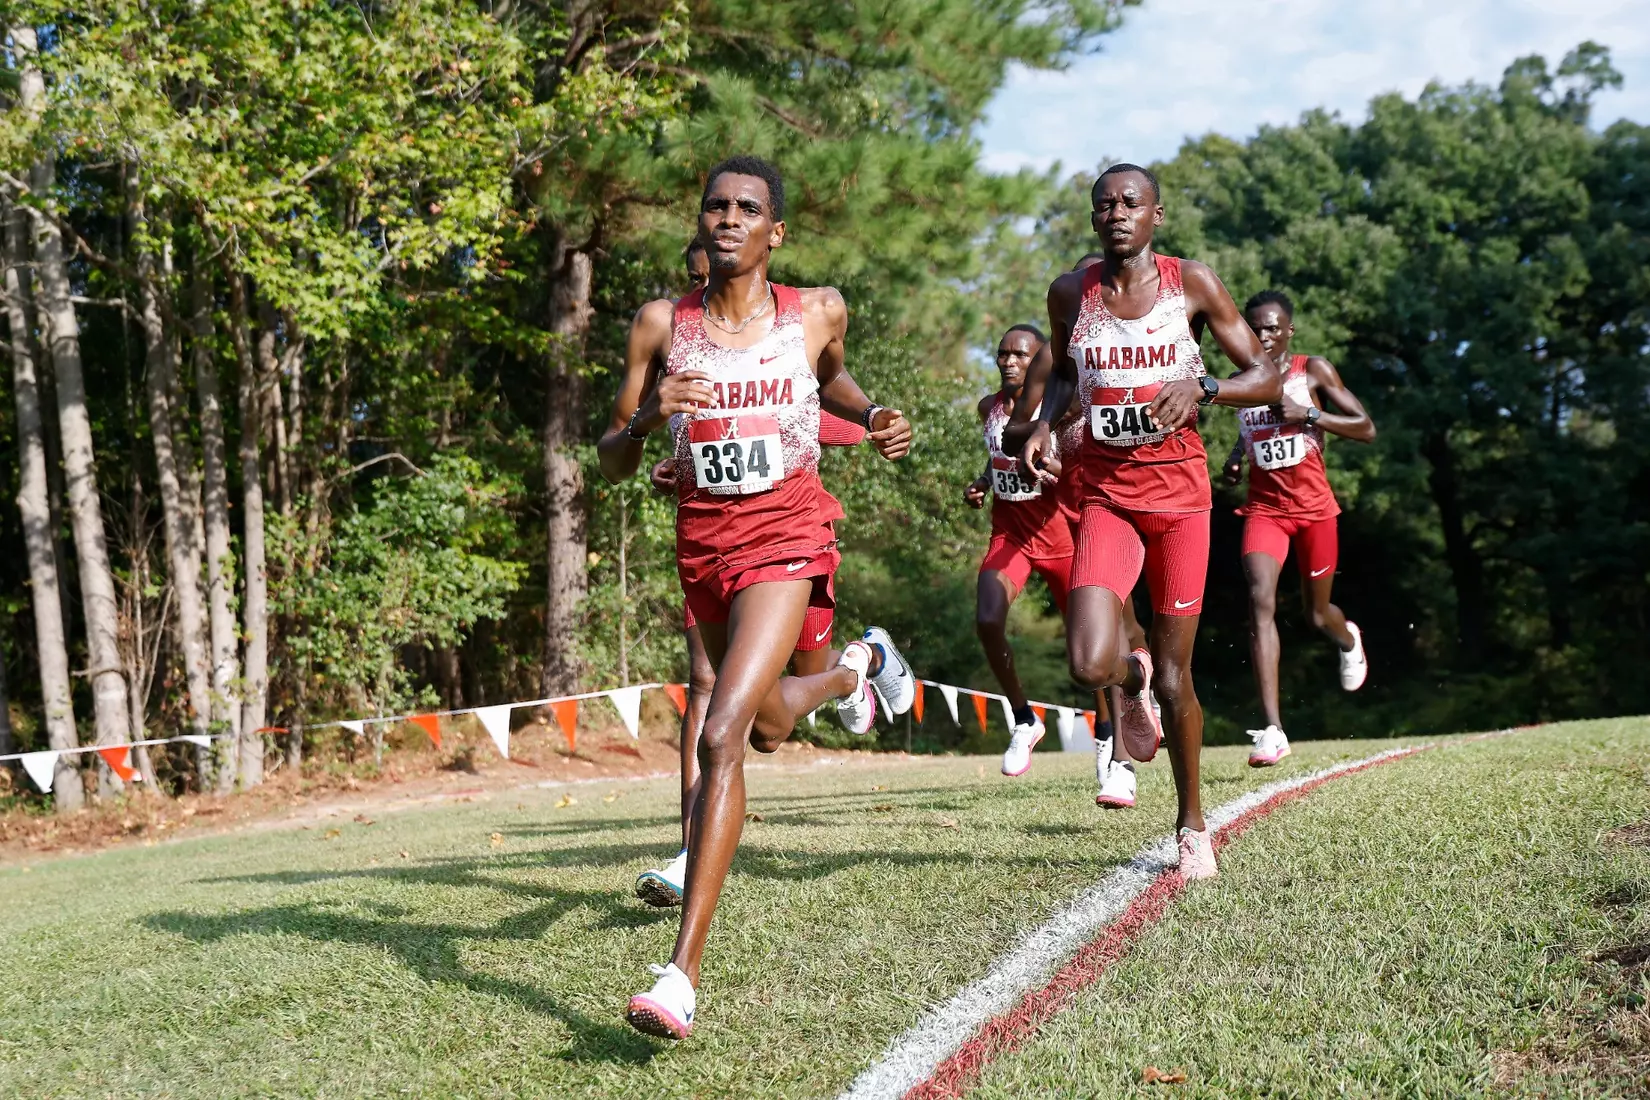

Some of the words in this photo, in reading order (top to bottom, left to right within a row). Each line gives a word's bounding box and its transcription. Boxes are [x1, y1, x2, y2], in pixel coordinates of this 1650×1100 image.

[1085, 344, 1176, 370] ALABAMA
[688, 378, 793, 409] ABAMA
[1118, 388, 1136, 404] A
[720, 418, 741, 439] A
[701, 439, 770, 484] 334
[1261, 437, 1296, 463] 337
